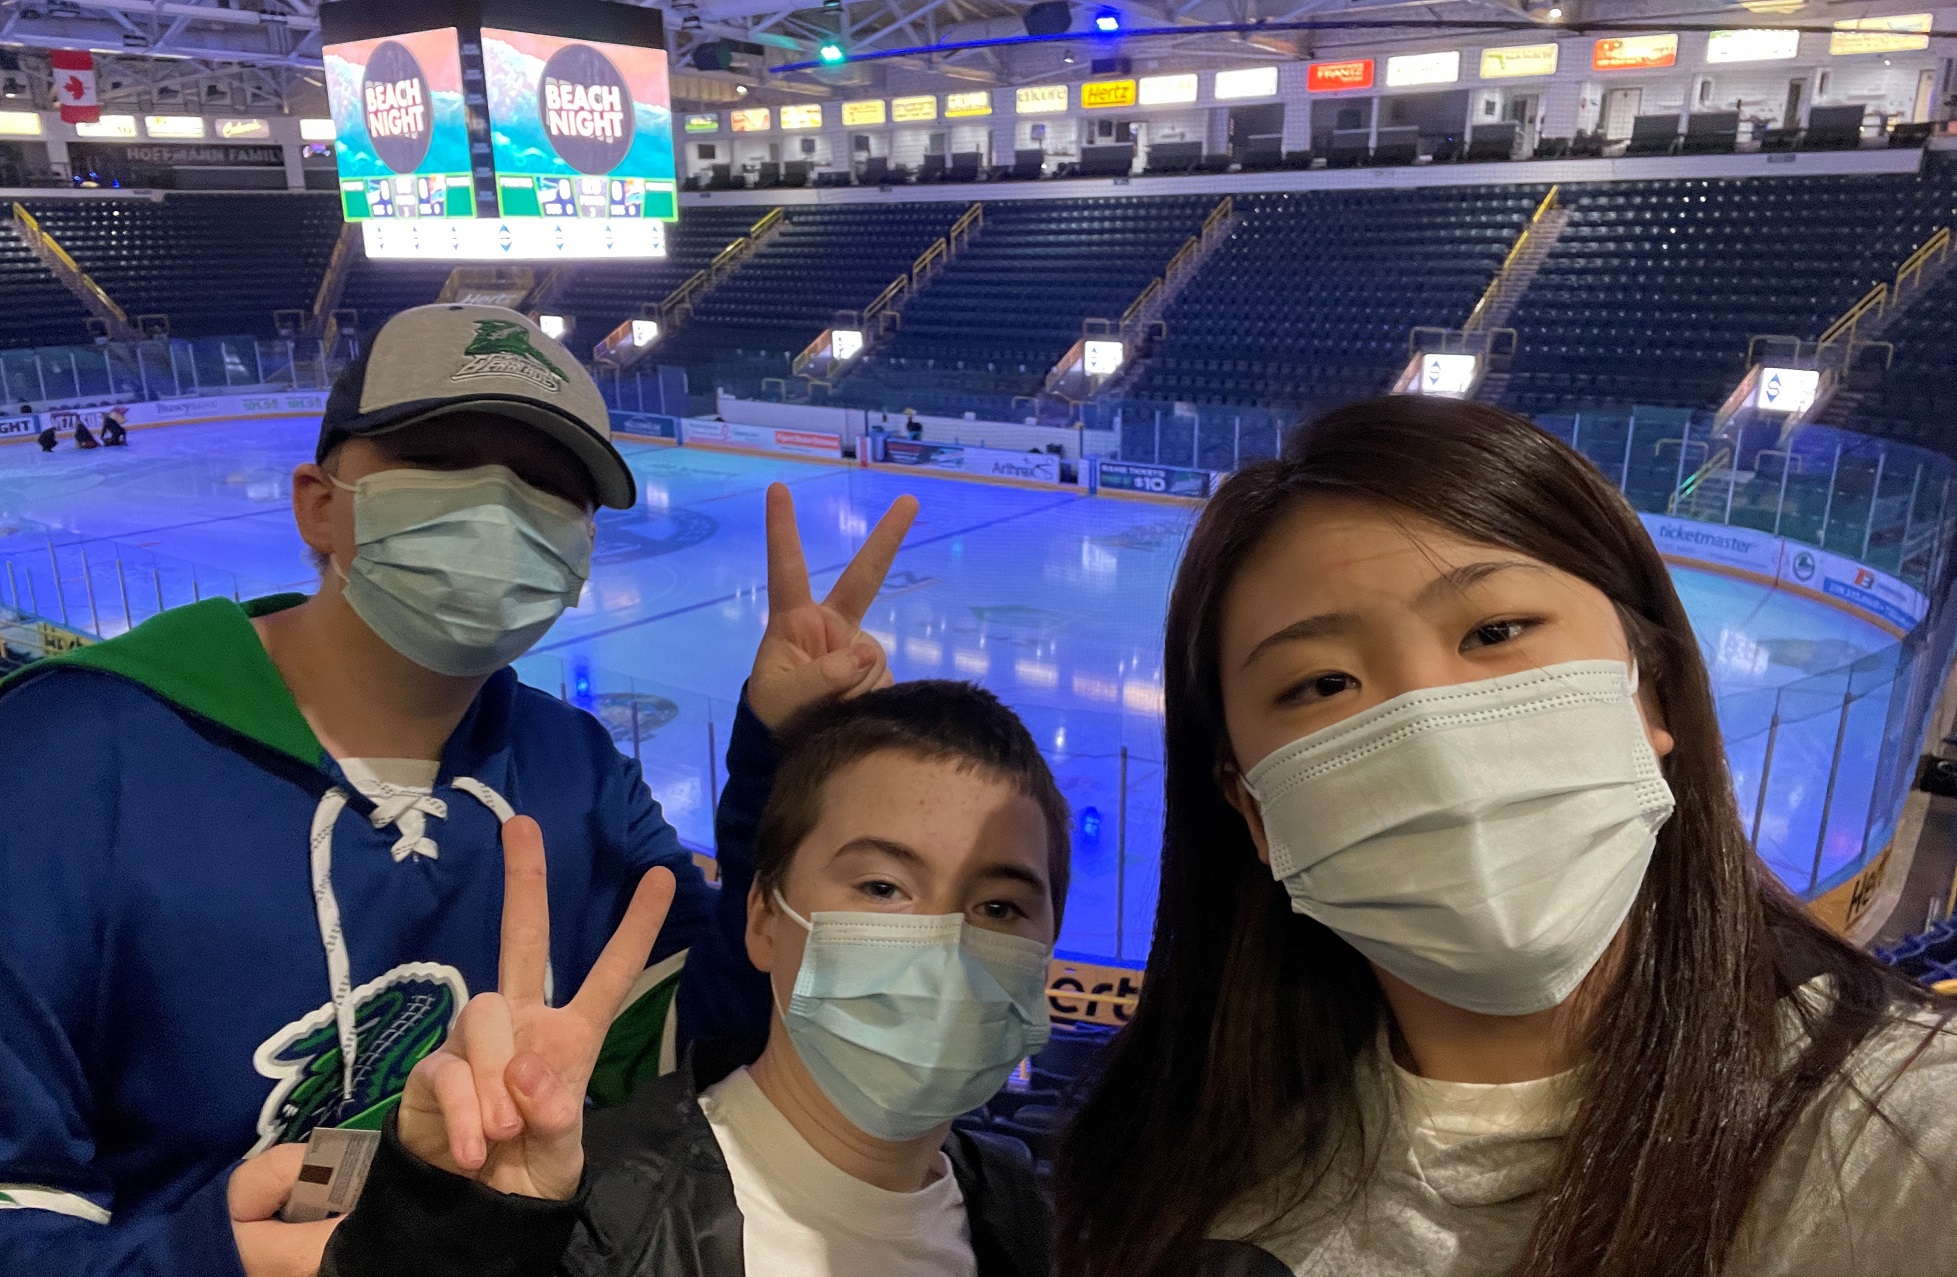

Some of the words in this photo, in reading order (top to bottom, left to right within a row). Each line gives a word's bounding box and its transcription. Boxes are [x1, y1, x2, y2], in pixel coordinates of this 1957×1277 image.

[365, 79, 421, 110] BEACH
[545, 83, 621, 112] BEACH
[1087, 85, 1129, 101] Hertz
[369, 105, 424, 138] NIGHT
[548, 110, 623, 137] NIGHT
[1134, 476, 1166, 492] $10
[1660, 524, 1750, 554] ticketmaster
